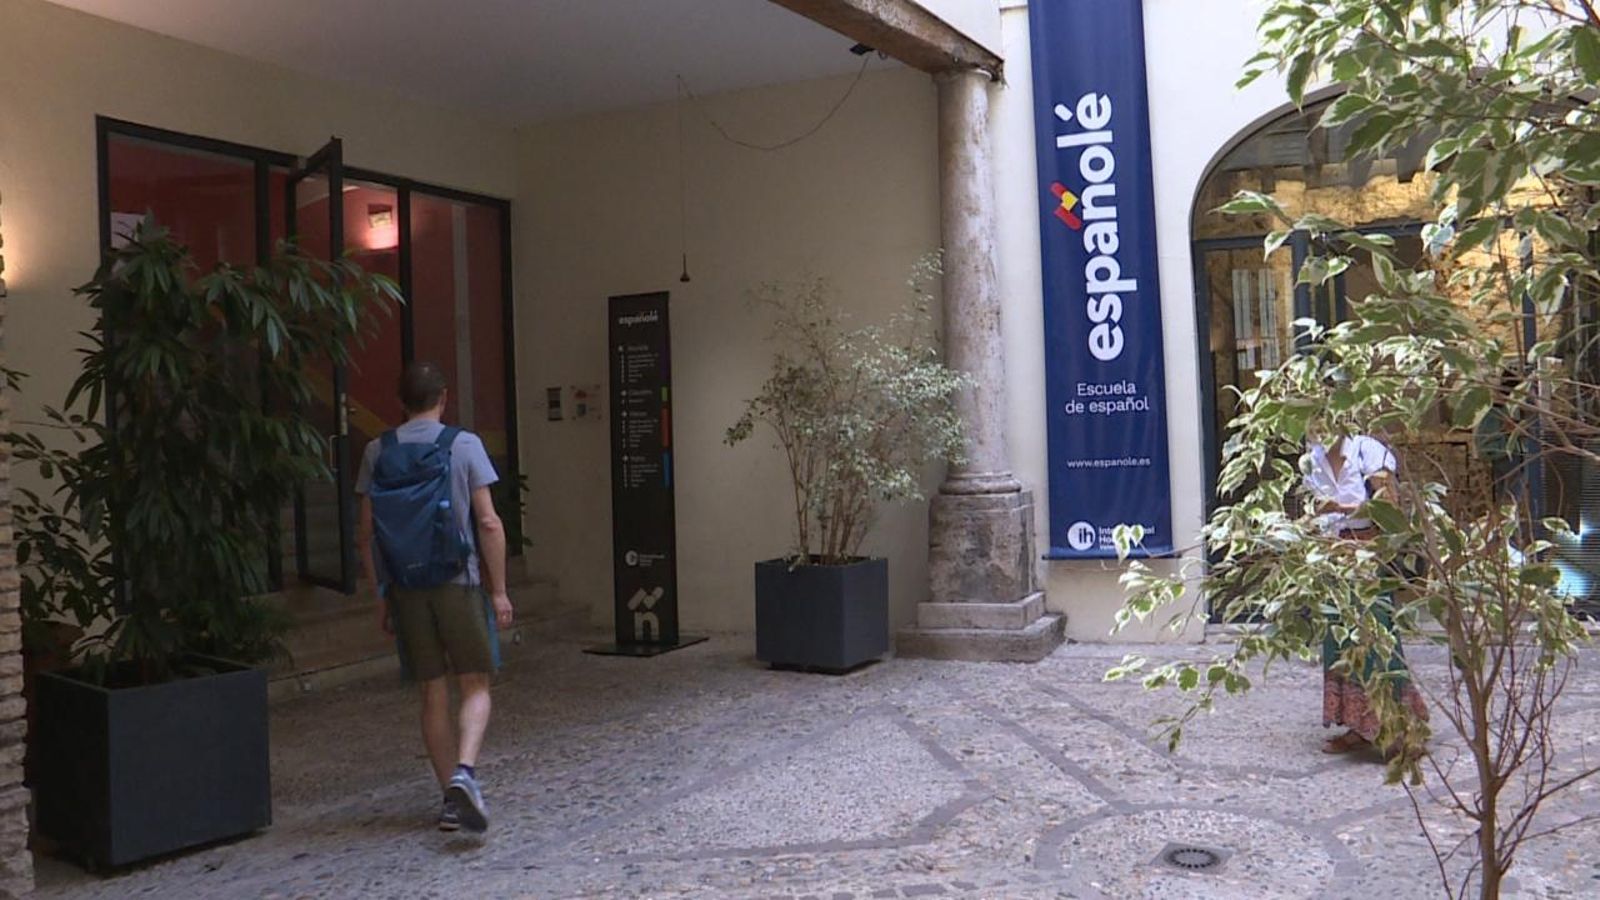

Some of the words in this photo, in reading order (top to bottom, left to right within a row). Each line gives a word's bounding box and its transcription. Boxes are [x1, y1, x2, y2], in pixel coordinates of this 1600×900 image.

[1076, 380, 1137, 397] Escuela
[1065, 400, 1085, 415] de
[1088, 396, 1150, 416] español
[1066, 456, 1151, 469] www.espanole.es
[1078, 527, 1094, 544] ih
